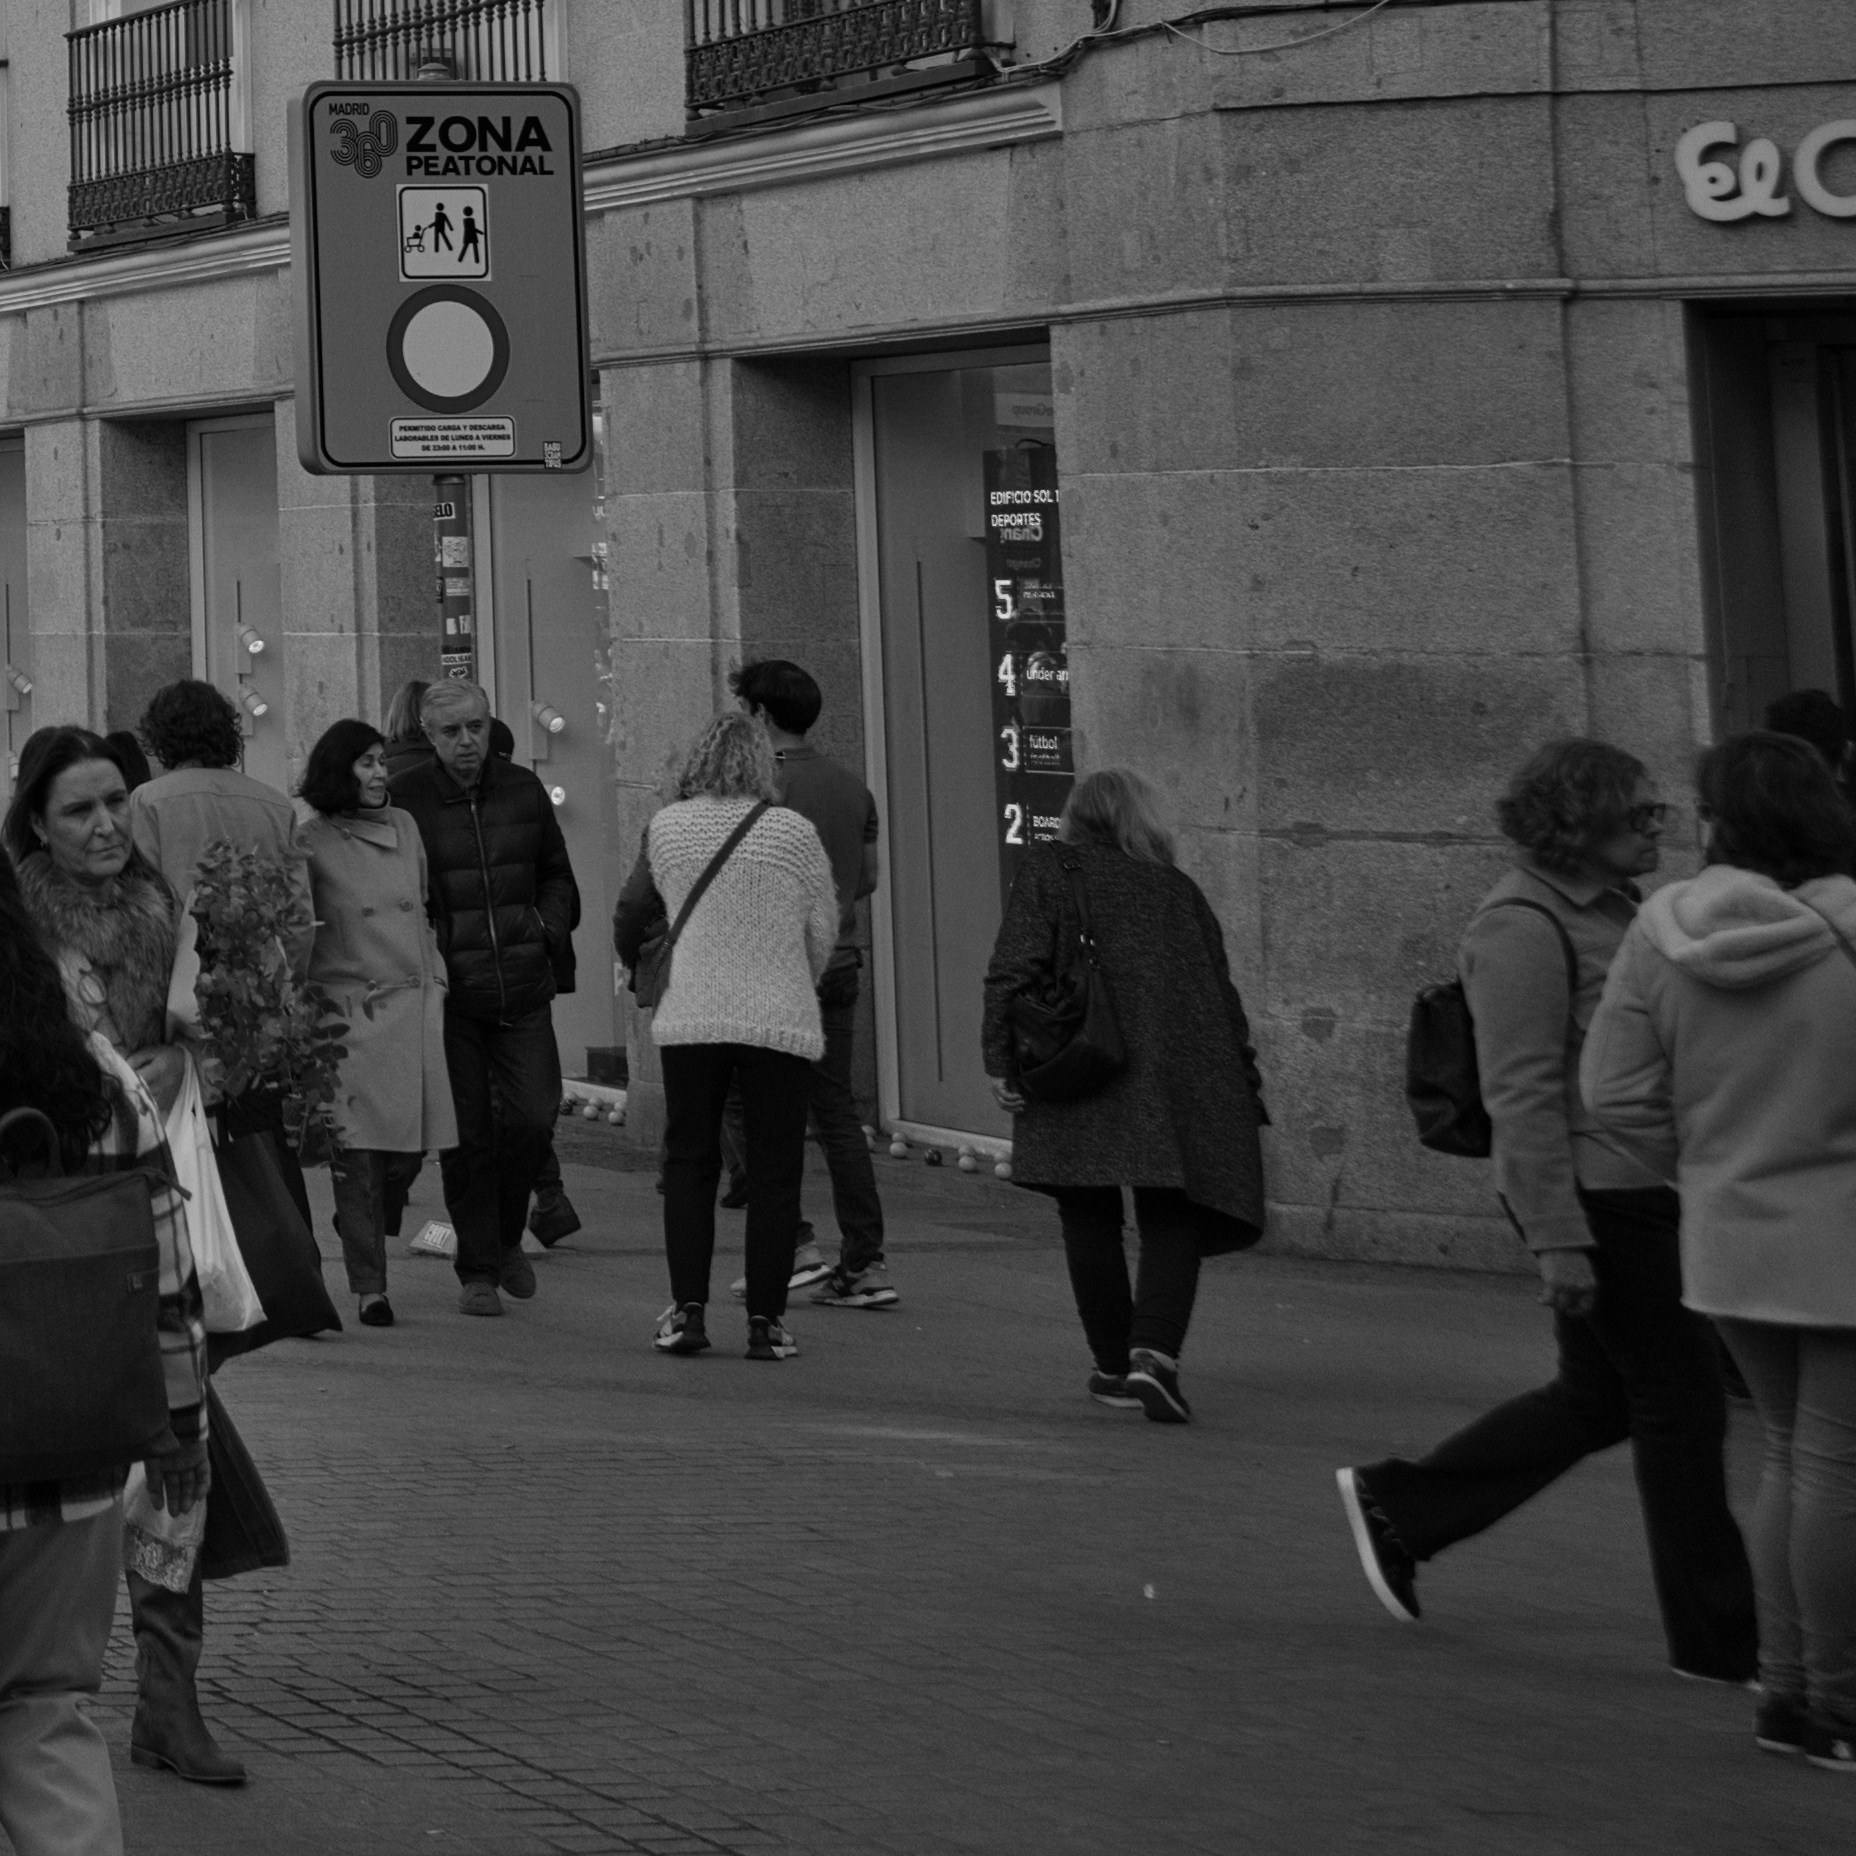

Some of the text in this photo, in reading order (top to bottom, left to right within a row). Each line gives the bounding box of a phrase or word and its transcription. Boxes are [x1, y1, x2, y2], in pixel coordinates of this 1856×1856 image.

[329, 102, 369, 115] MADRID
[330, 110, 398, 178] 360
[405, 116, 552, 152] ZONA
[406, 155, 554, 176] PEATONAL
[1674, 120, 1791, 222] El
[990, 490, 1031, 505] EDIFICIO
[1033, 489, 1054, 503] SOL
[991, 513, 1042, 528] DEPORTES
[994, 579, 1013, 620] 5
[998, 653, 1016, 697] 4
[1026, 668, 1055, 680] under
[1000, 728, 1020, 771] 3
[1004, 803, 1023, 845] 2
